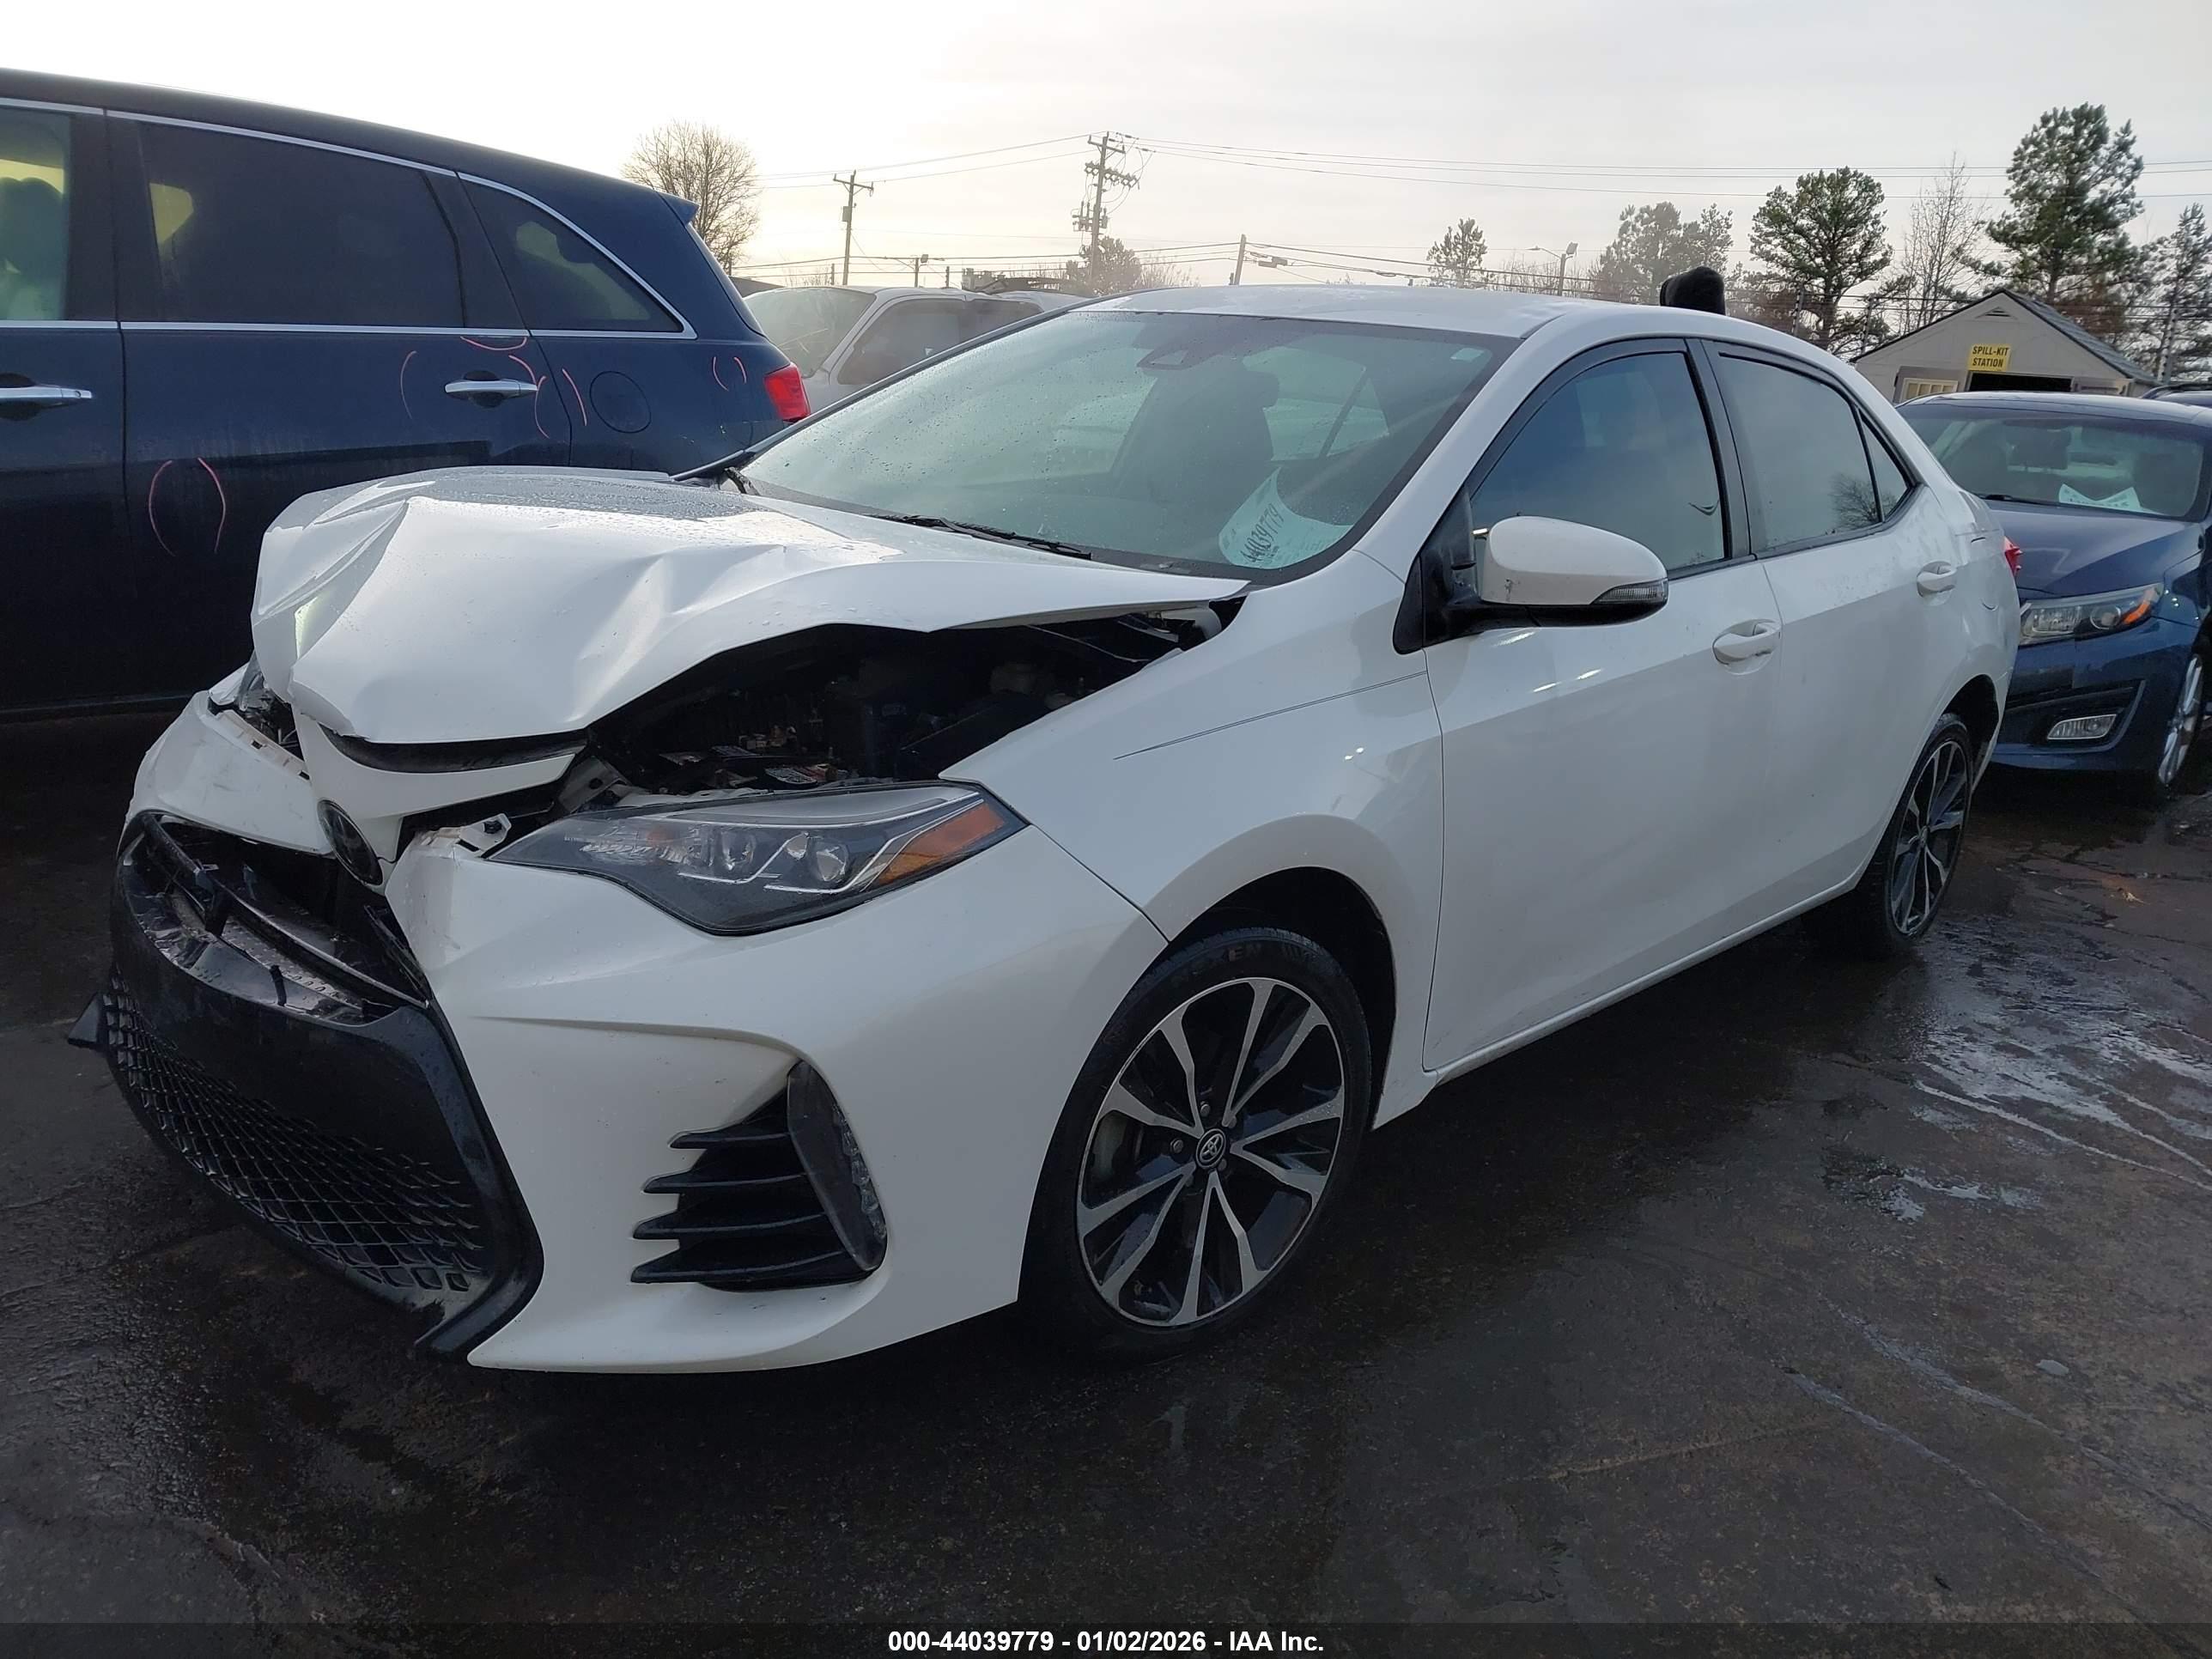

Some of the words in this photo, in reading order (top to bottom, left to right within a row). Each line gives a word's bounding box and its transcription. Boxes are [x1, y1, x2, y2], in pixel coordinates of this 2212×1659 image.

[1972, 345, 2009, 356] SPILL-KIT
[1972, 357, 2004, 368] STATION
[1240, 503, 1285, 562] 44039779
